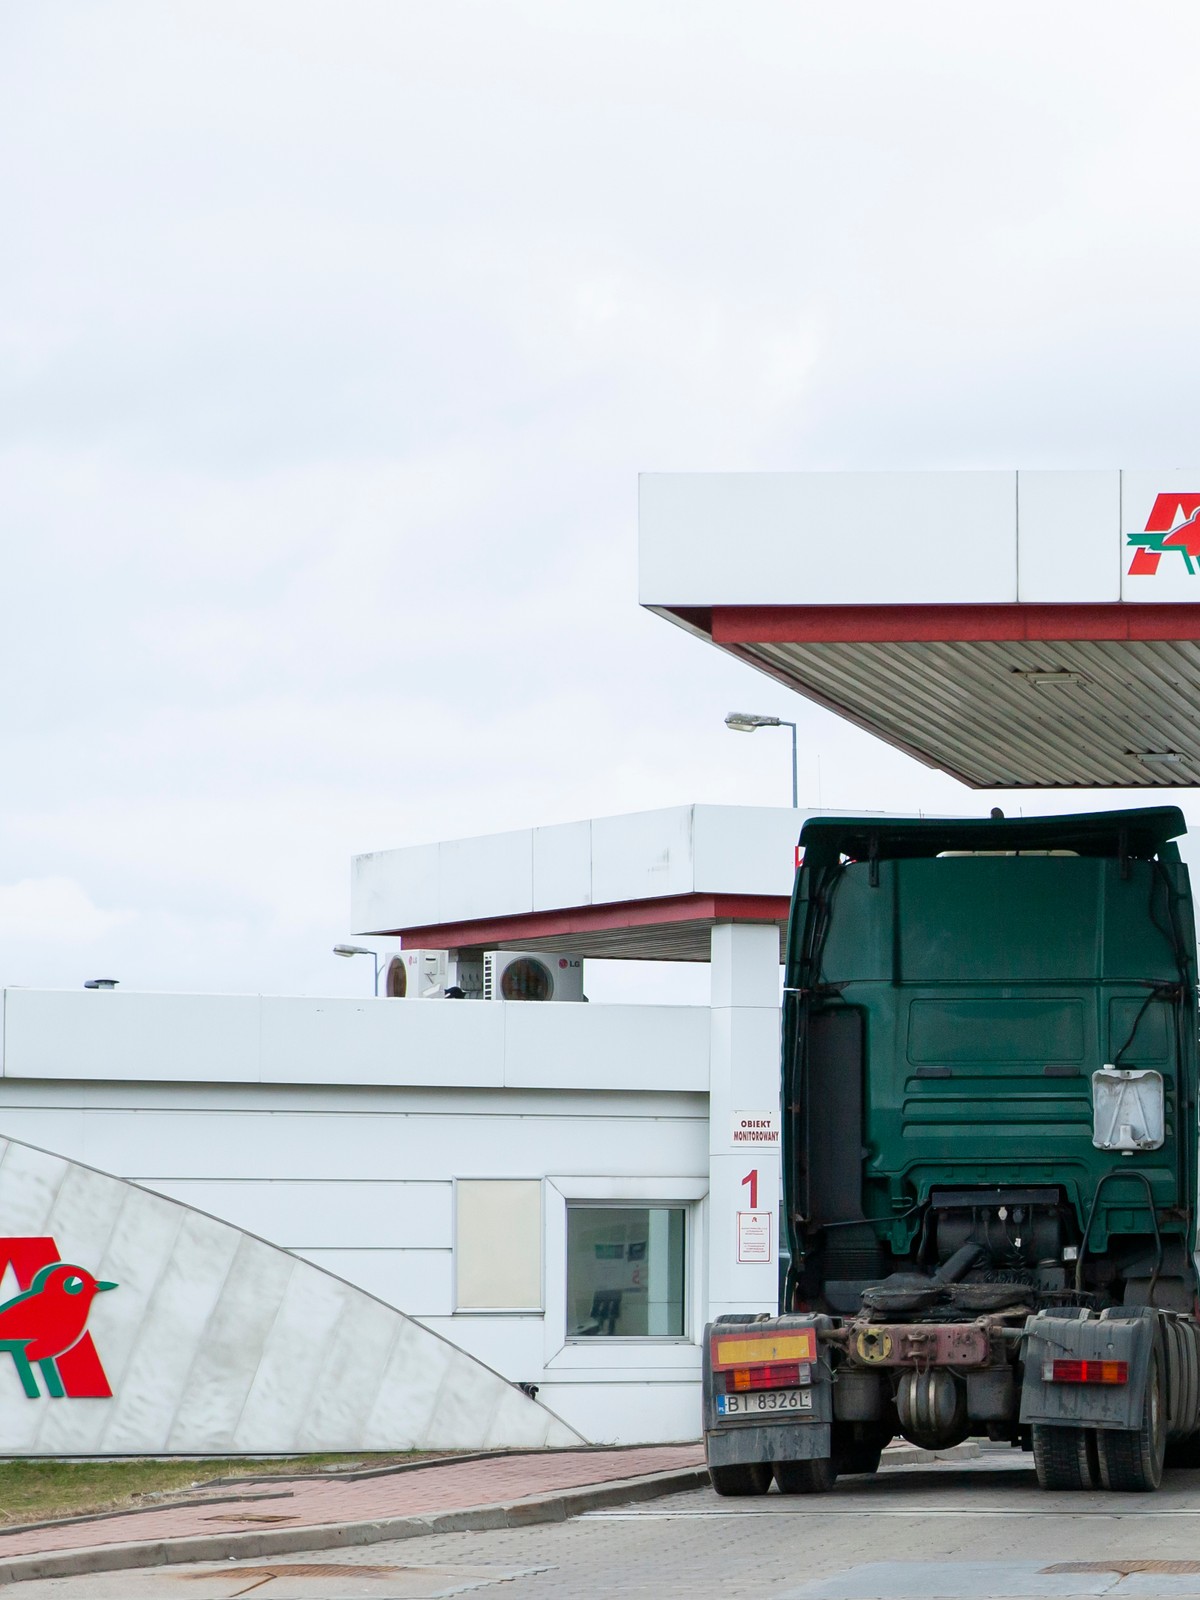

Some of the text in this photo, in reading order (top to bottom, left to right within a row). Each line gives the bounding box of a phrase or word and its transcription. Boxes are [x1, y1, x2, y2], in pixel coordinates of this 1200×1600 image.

[740, 1120, 771, 1128] OBIEKT
[733, 1130, 779, 1142] MONITOROWANY
[741, 1169, 758, 1209] 1
[727, 1391, 809, 1412] BI 8326L
